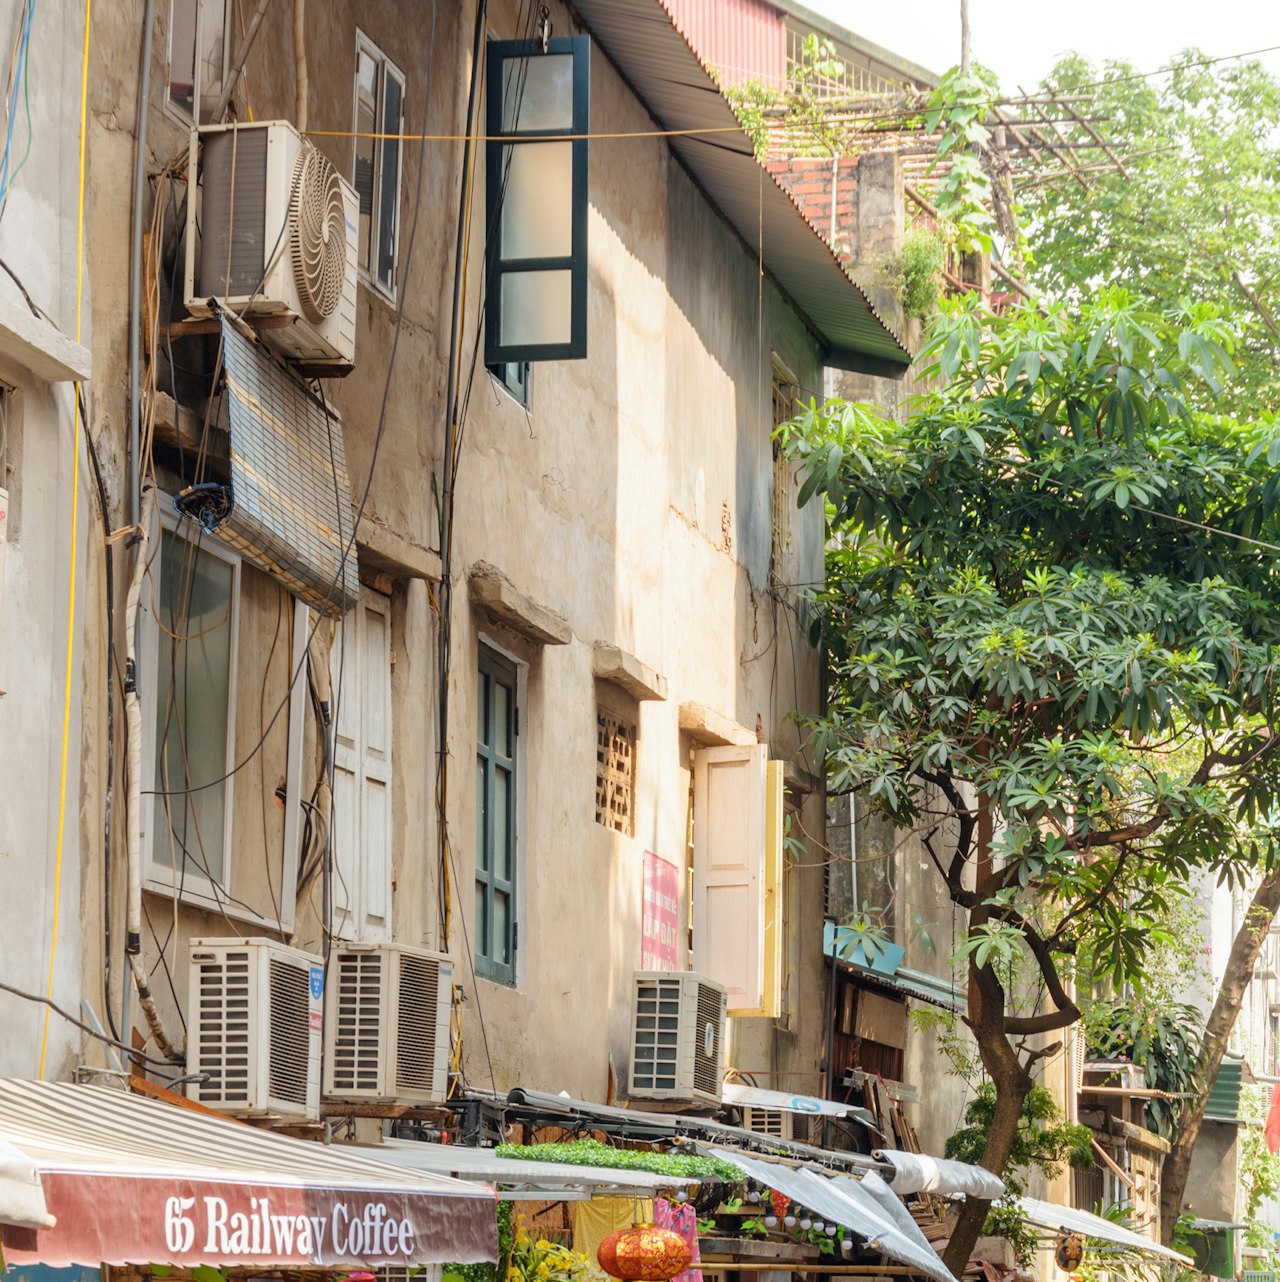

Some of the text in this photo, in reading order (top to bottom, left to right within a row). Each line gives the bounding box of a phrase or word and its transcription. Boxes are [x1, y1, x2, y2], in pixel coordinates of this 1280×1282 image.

[165, 1196, 414, 1264] 65 Railway Coffee
